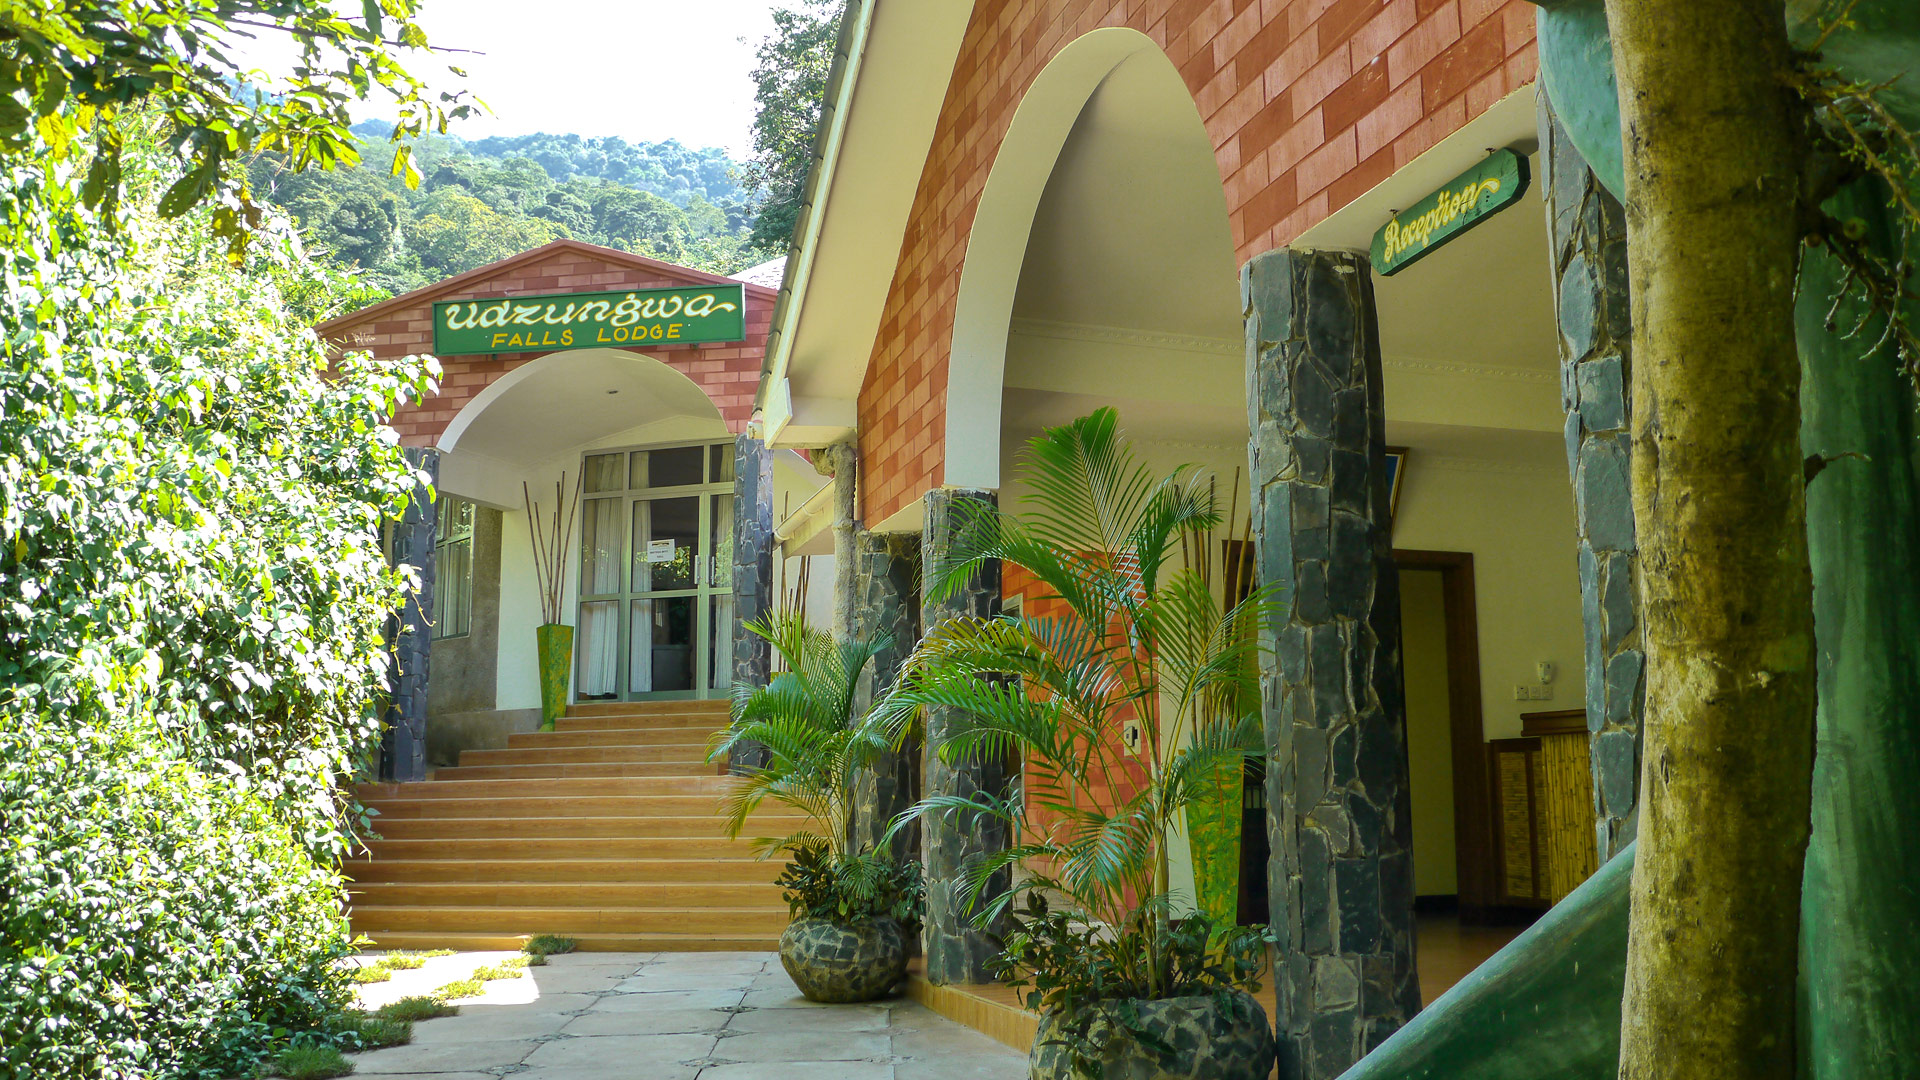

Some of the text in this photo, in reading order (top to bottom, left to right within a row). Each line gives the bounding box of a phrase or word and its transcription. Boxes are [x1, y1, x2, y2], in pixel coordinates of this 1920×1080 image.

[1384, 178, 1500, 263] Reception
[491, 323, 683, 348] FALLS LODGE
